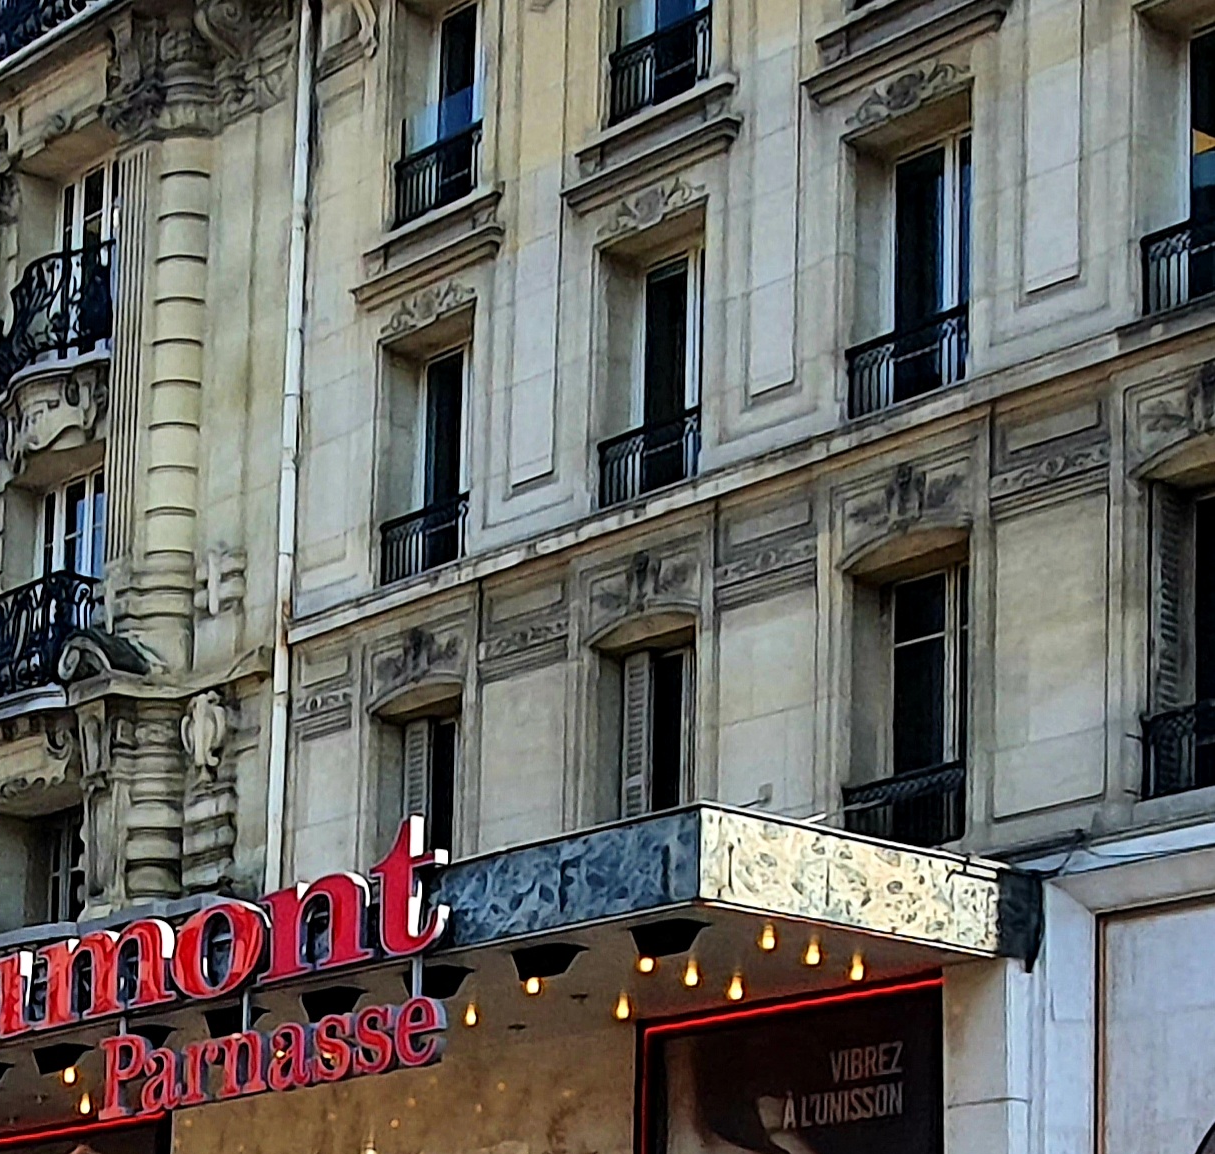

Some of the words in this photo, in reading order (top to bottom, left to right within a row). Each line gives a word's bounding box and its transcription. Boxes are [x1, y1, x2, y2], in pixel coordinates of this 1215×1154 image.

[98, 997, 446, 1121] Parnasse
[829, 1041, 904, 1083] VIBREZ
[783, 1090, 796, 1130] À
[800, 1081, 903, 1128] L'UNISSON
